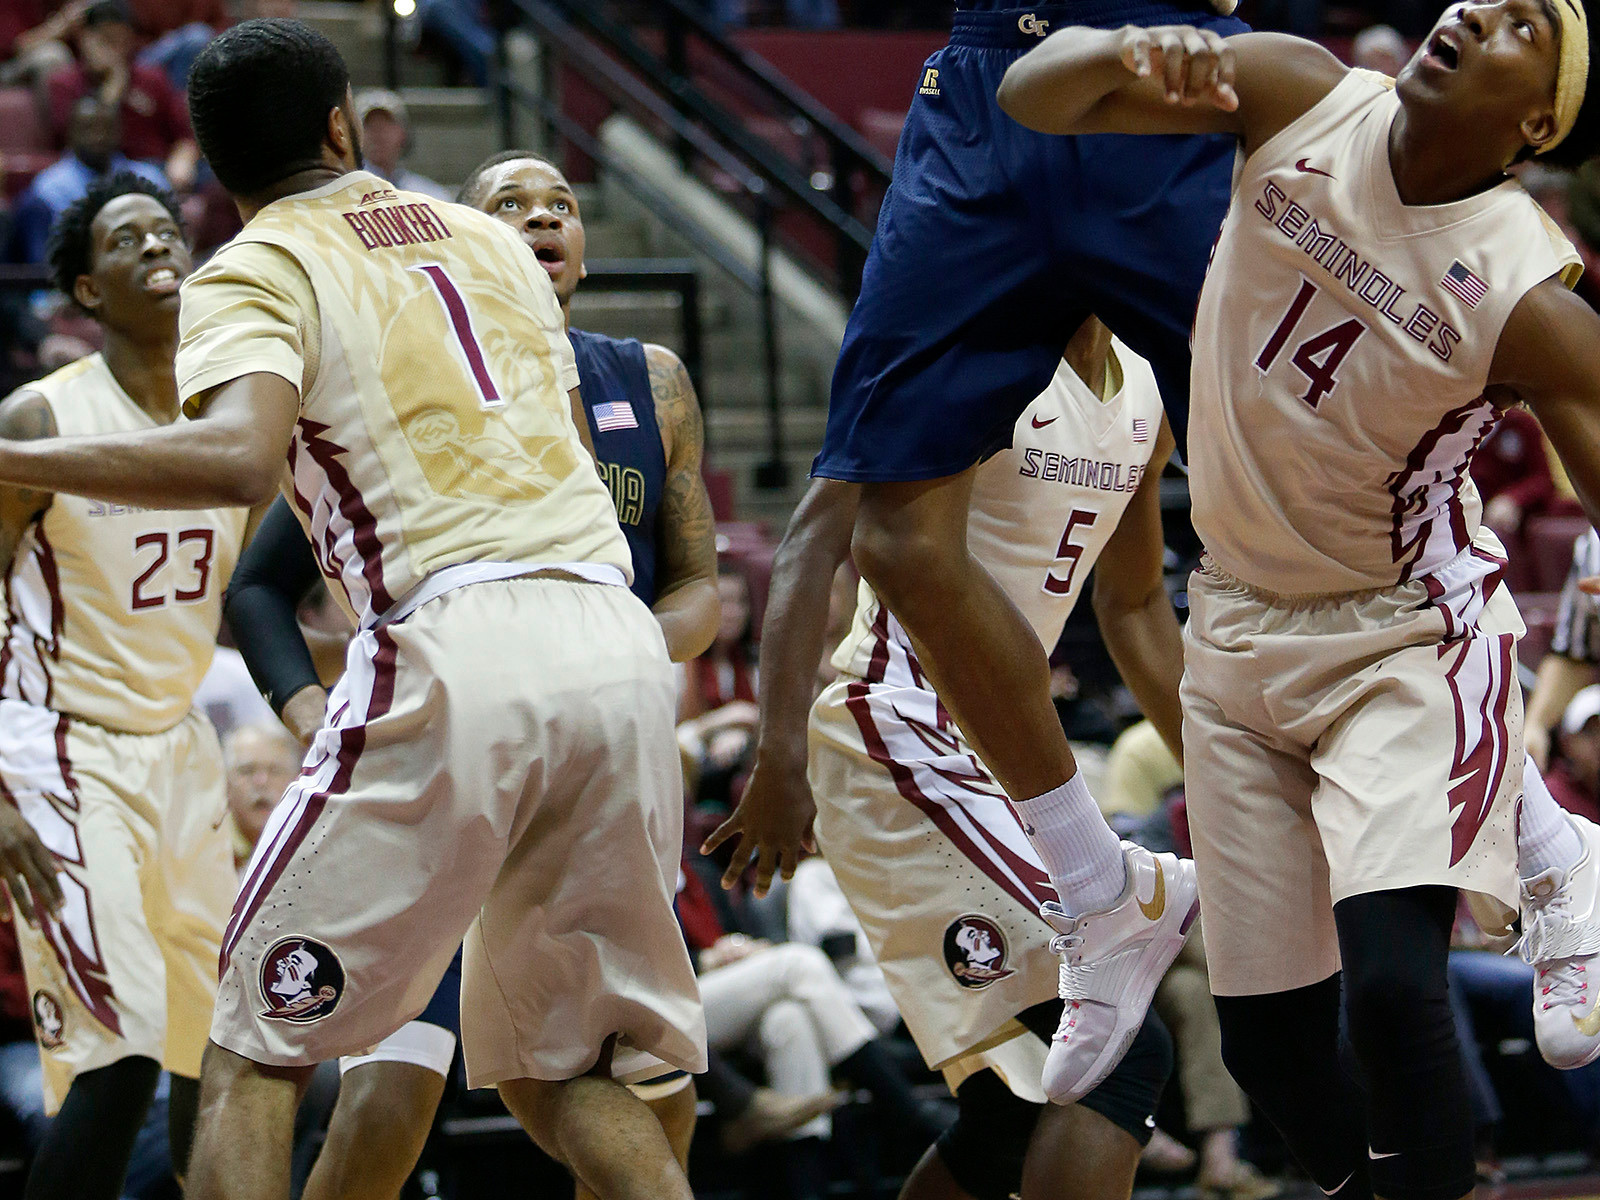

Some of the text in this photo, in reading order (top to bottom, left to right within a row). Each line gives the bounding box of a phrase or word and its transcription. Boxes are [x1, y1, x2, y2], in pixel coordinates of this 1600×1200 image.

[342, 203, 453, 251] BOOKERT
[359, 189, 398, 206] ACC
[1254, 179, 1462, 363] SEMINOLES
[405, 261, 505, 408] 1
[1251, 270, 1370, 412] 14
[128, 525, 216, 614] 23
[1040, 506, 1099, 597] 5
